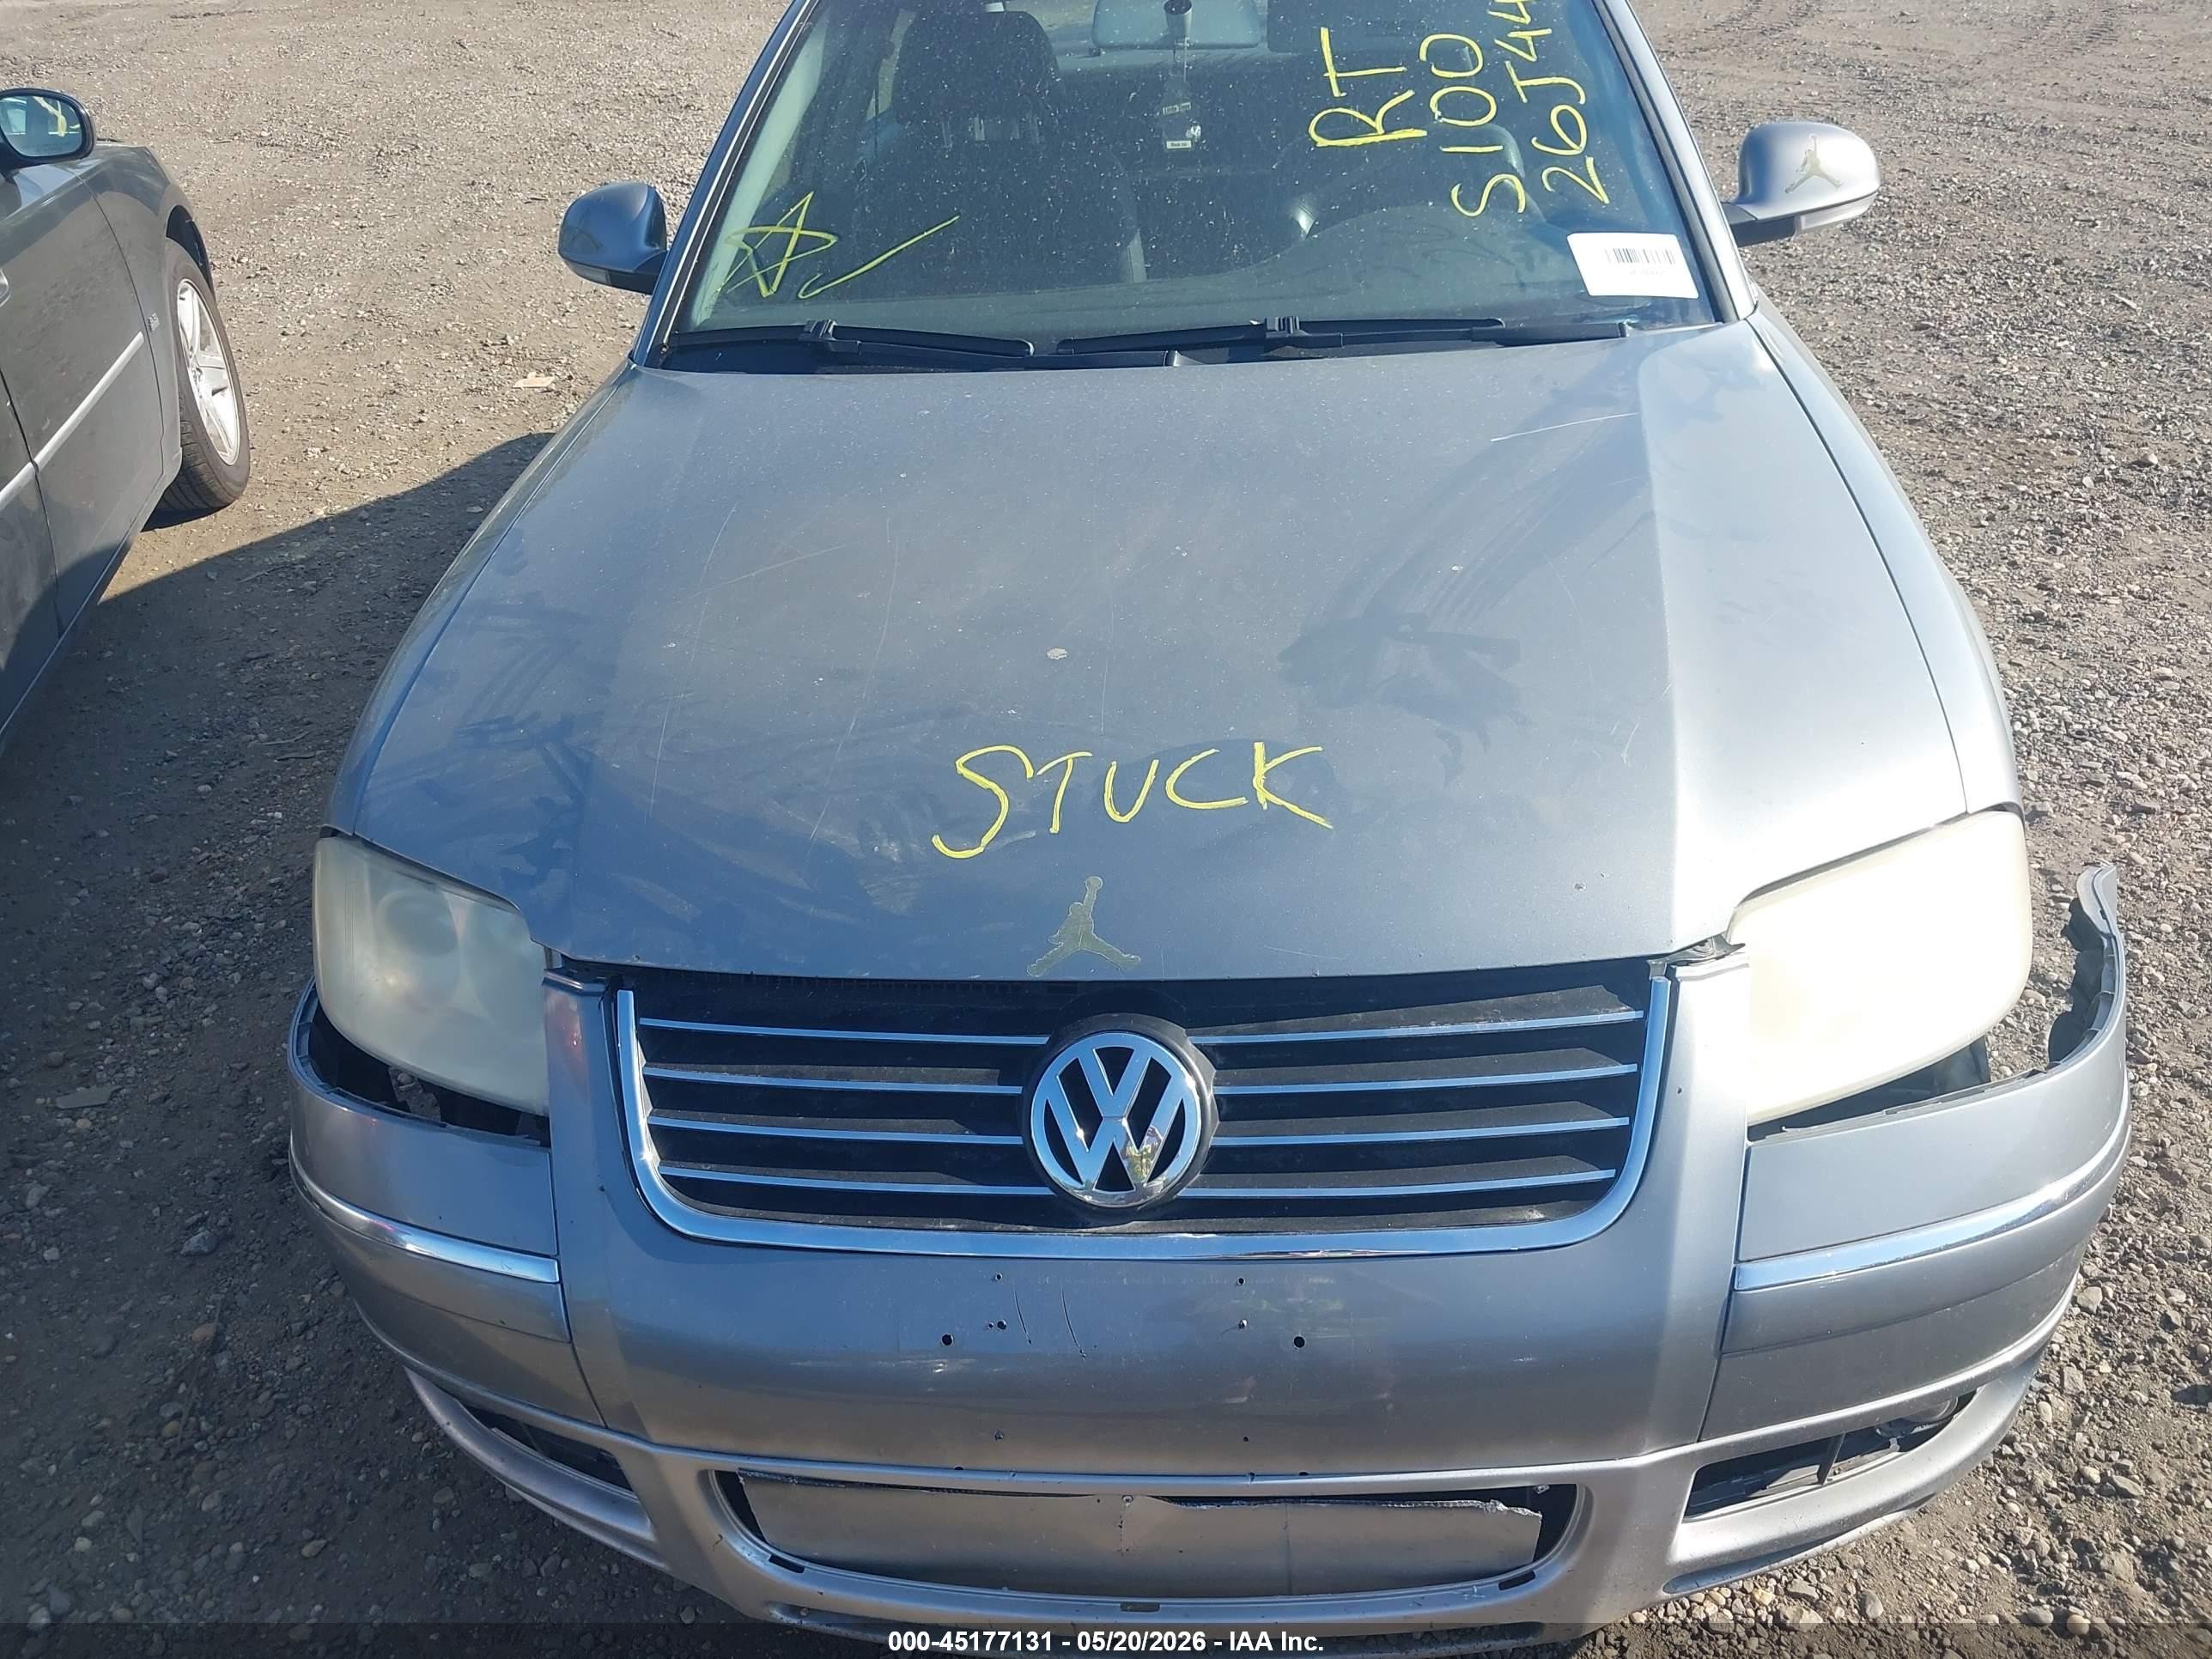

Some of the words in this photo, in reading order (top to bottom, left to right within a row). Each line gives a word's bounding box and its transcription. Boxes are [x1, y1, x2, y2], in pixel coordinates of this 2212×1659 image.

[1309, 27, 1428, 147] RT
[932, 741, 1334, 859] STUCK
[1033, 1034, 1199, 1206] VW
